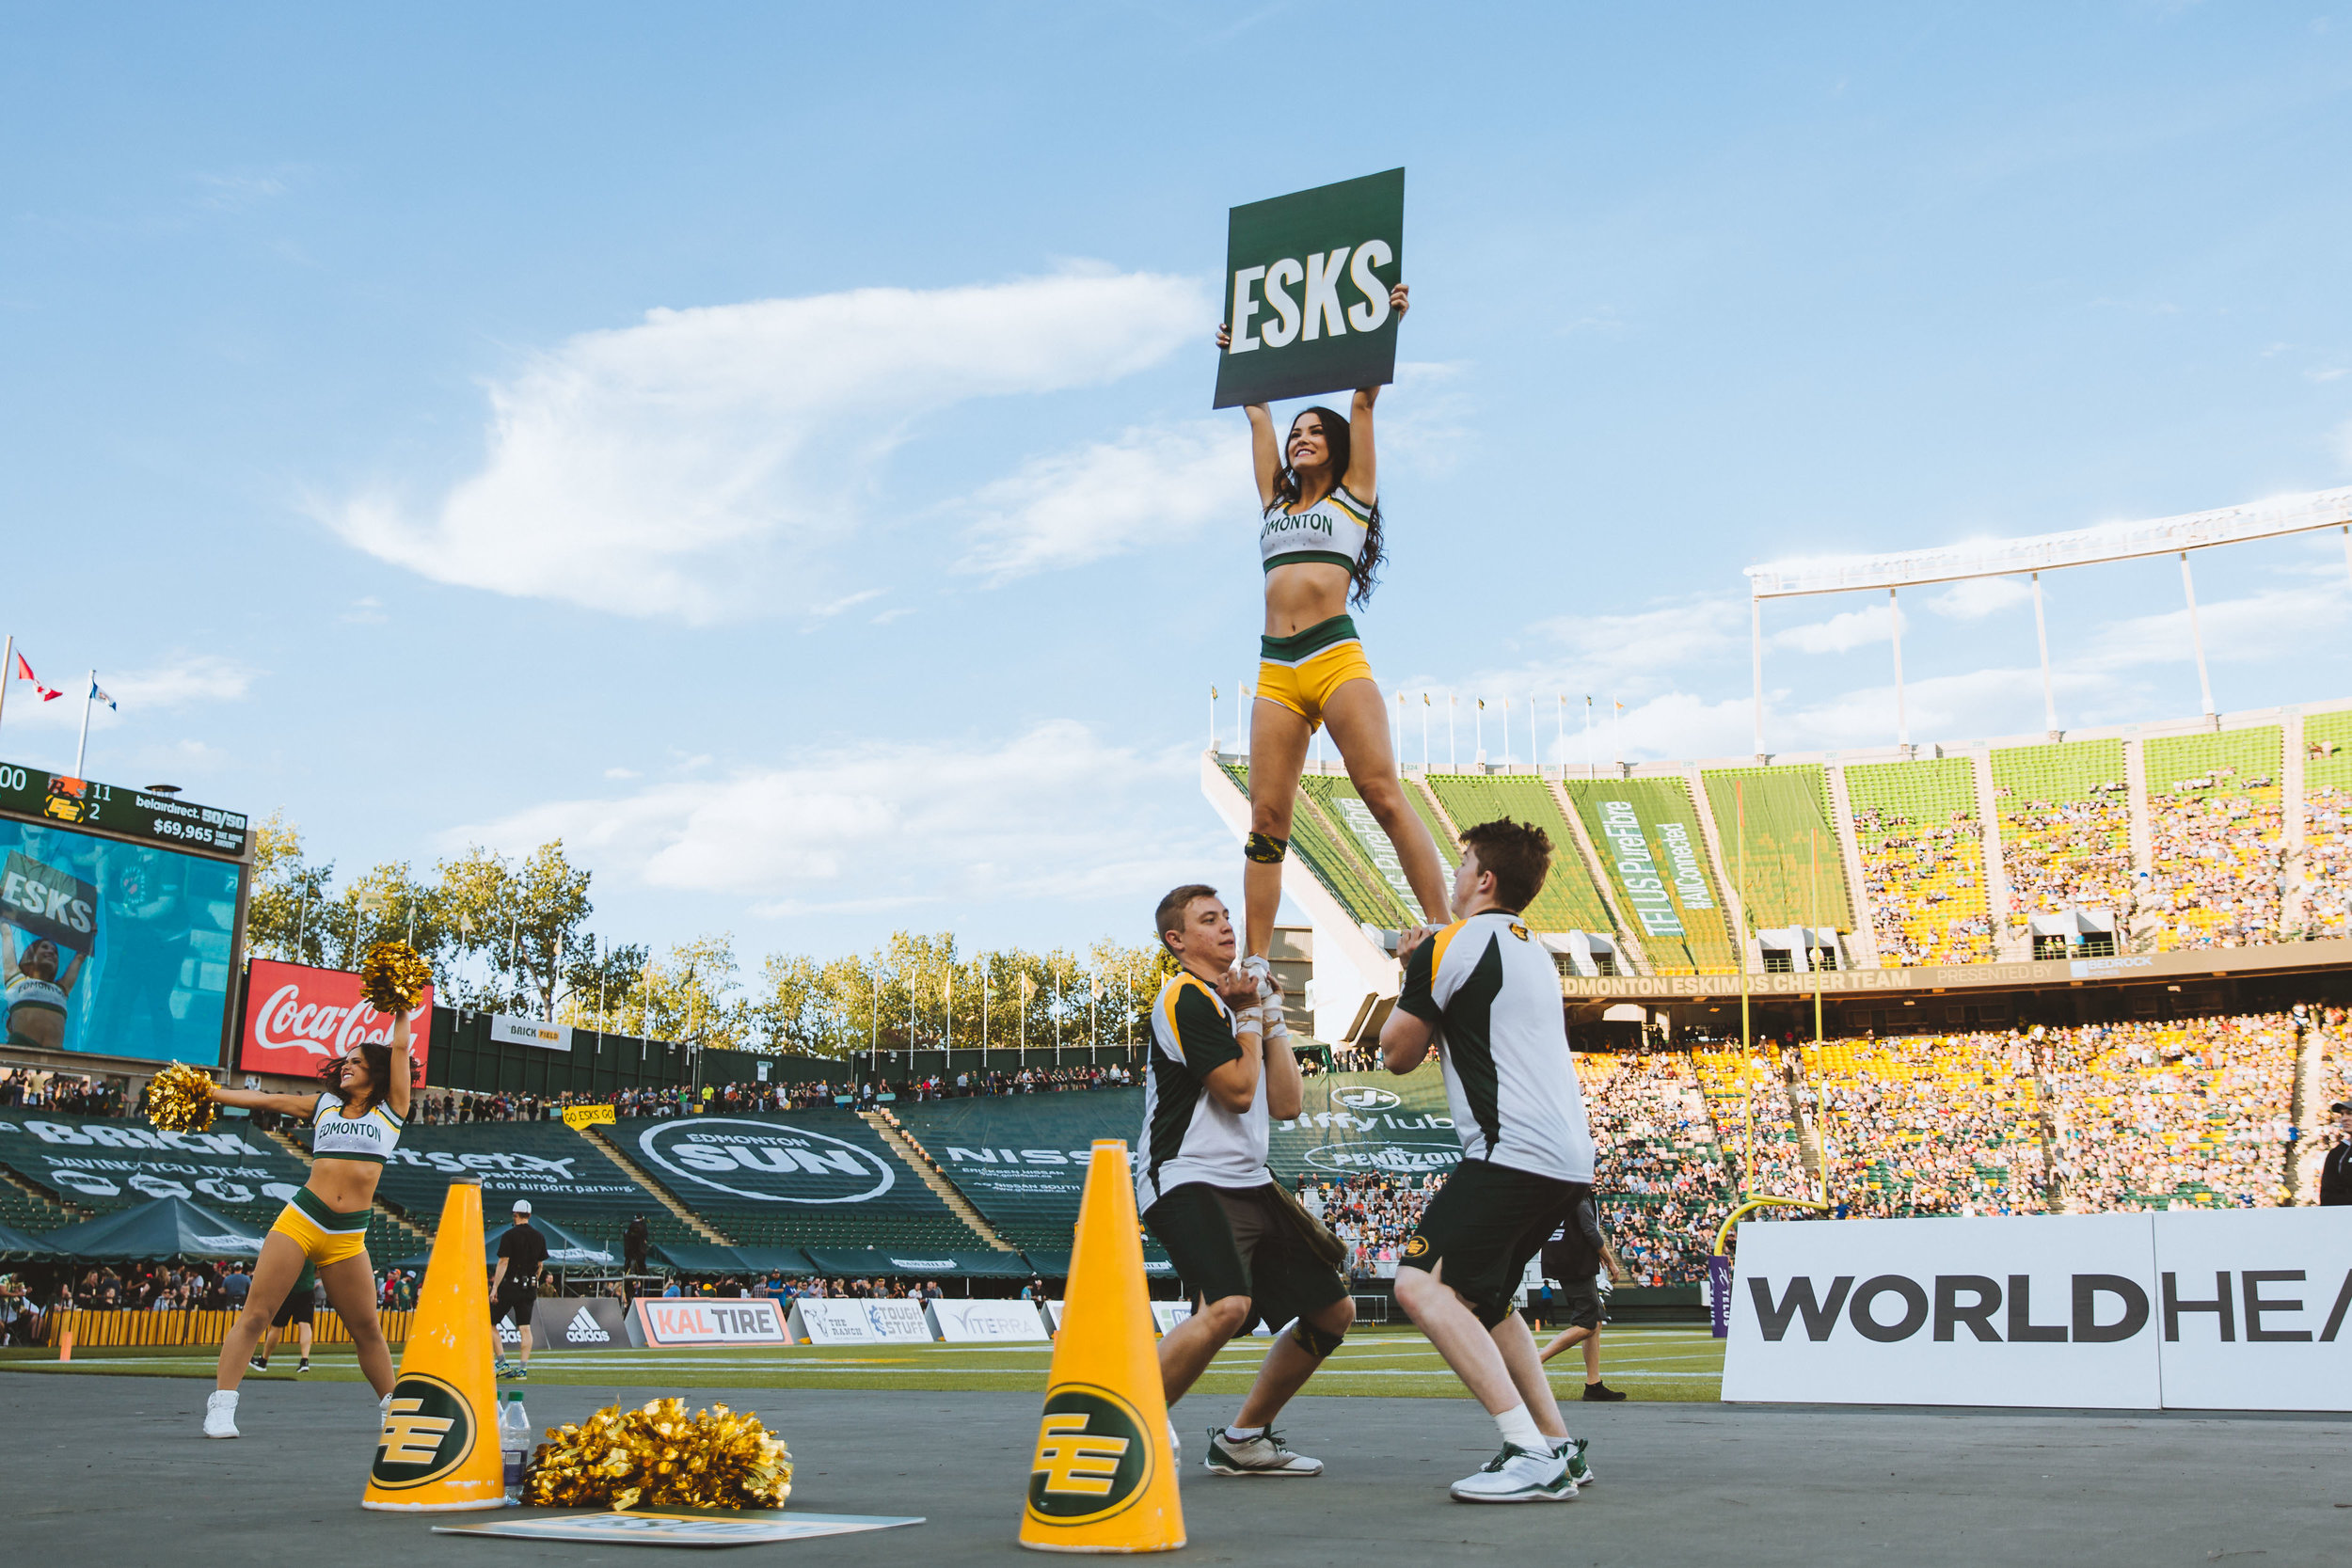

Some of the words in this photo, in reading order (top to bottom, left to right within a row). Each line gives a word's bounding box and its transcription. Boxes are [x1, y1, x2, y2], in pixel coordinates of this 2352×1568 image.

[1230, 239, 1392, 355] ESKS
[93, 784, 111, 801] 11
[89, 803, 101, 820] 2
[201, 809, 246, 830] 50/50
[153, 817, 214, 842] $69,965
[1602, 800, 1658, 874] PureFibre
[1656, 822, 1714, 909] #AllConnected
[1, 871, 93, 933] ESKS
[1624, 878, 1684, 937] TELUS
[2089, 956, 2153, 970] BEDROCK
[1673, 974, 1769, 994] ESKIMOS
[1772, 972, 1844, 991] CHEER
[1849, 970, 1912, 990] TEAM
[1936, 966, 2030, 983] PRESENTED
[2033, 964, 2053, 979] BY
[511, 1025, 536, 1037] BRICK
[539, 1030, 559, 1040] FIELD
[564, 1113, 577, 1123] GO
[579, 1110, 599, 1120] ESKS
[602, 1109, 613, 1119] GO
[1383, 1114, 1455, 1129] lub
[319, 1122, 381, 1142] EDMONTON
[687, 1133, 811, 1148] EDMONTON
[41, 1155, 140, 1171] SAVING
[141, 1162, 197, 1174] YOU
[199, 1164, 276, 1179] MORE
[671, 1144, 870, 1175] SUN
[477, 1170, 558, 1183] parking
[496, 1181, 516, 1190] on
[519, 1181, 572, 1193] airport
[575, 1184, 636, 1194] parking.
[879, 1307, 921, 1319] TOUGH
[1747, 1274, 2150, 1342] WORLD
[711, 1309, 774, 1334] TIRE
[829, 1319, 848, 1327] THE
[884, 1322, 926, 1335] STUFF
[950, 1305, 1036, 1334] VITERRA
[566, 1328, 611, 1342] adidas
[832, 1327, 863, 1336] RANCH
